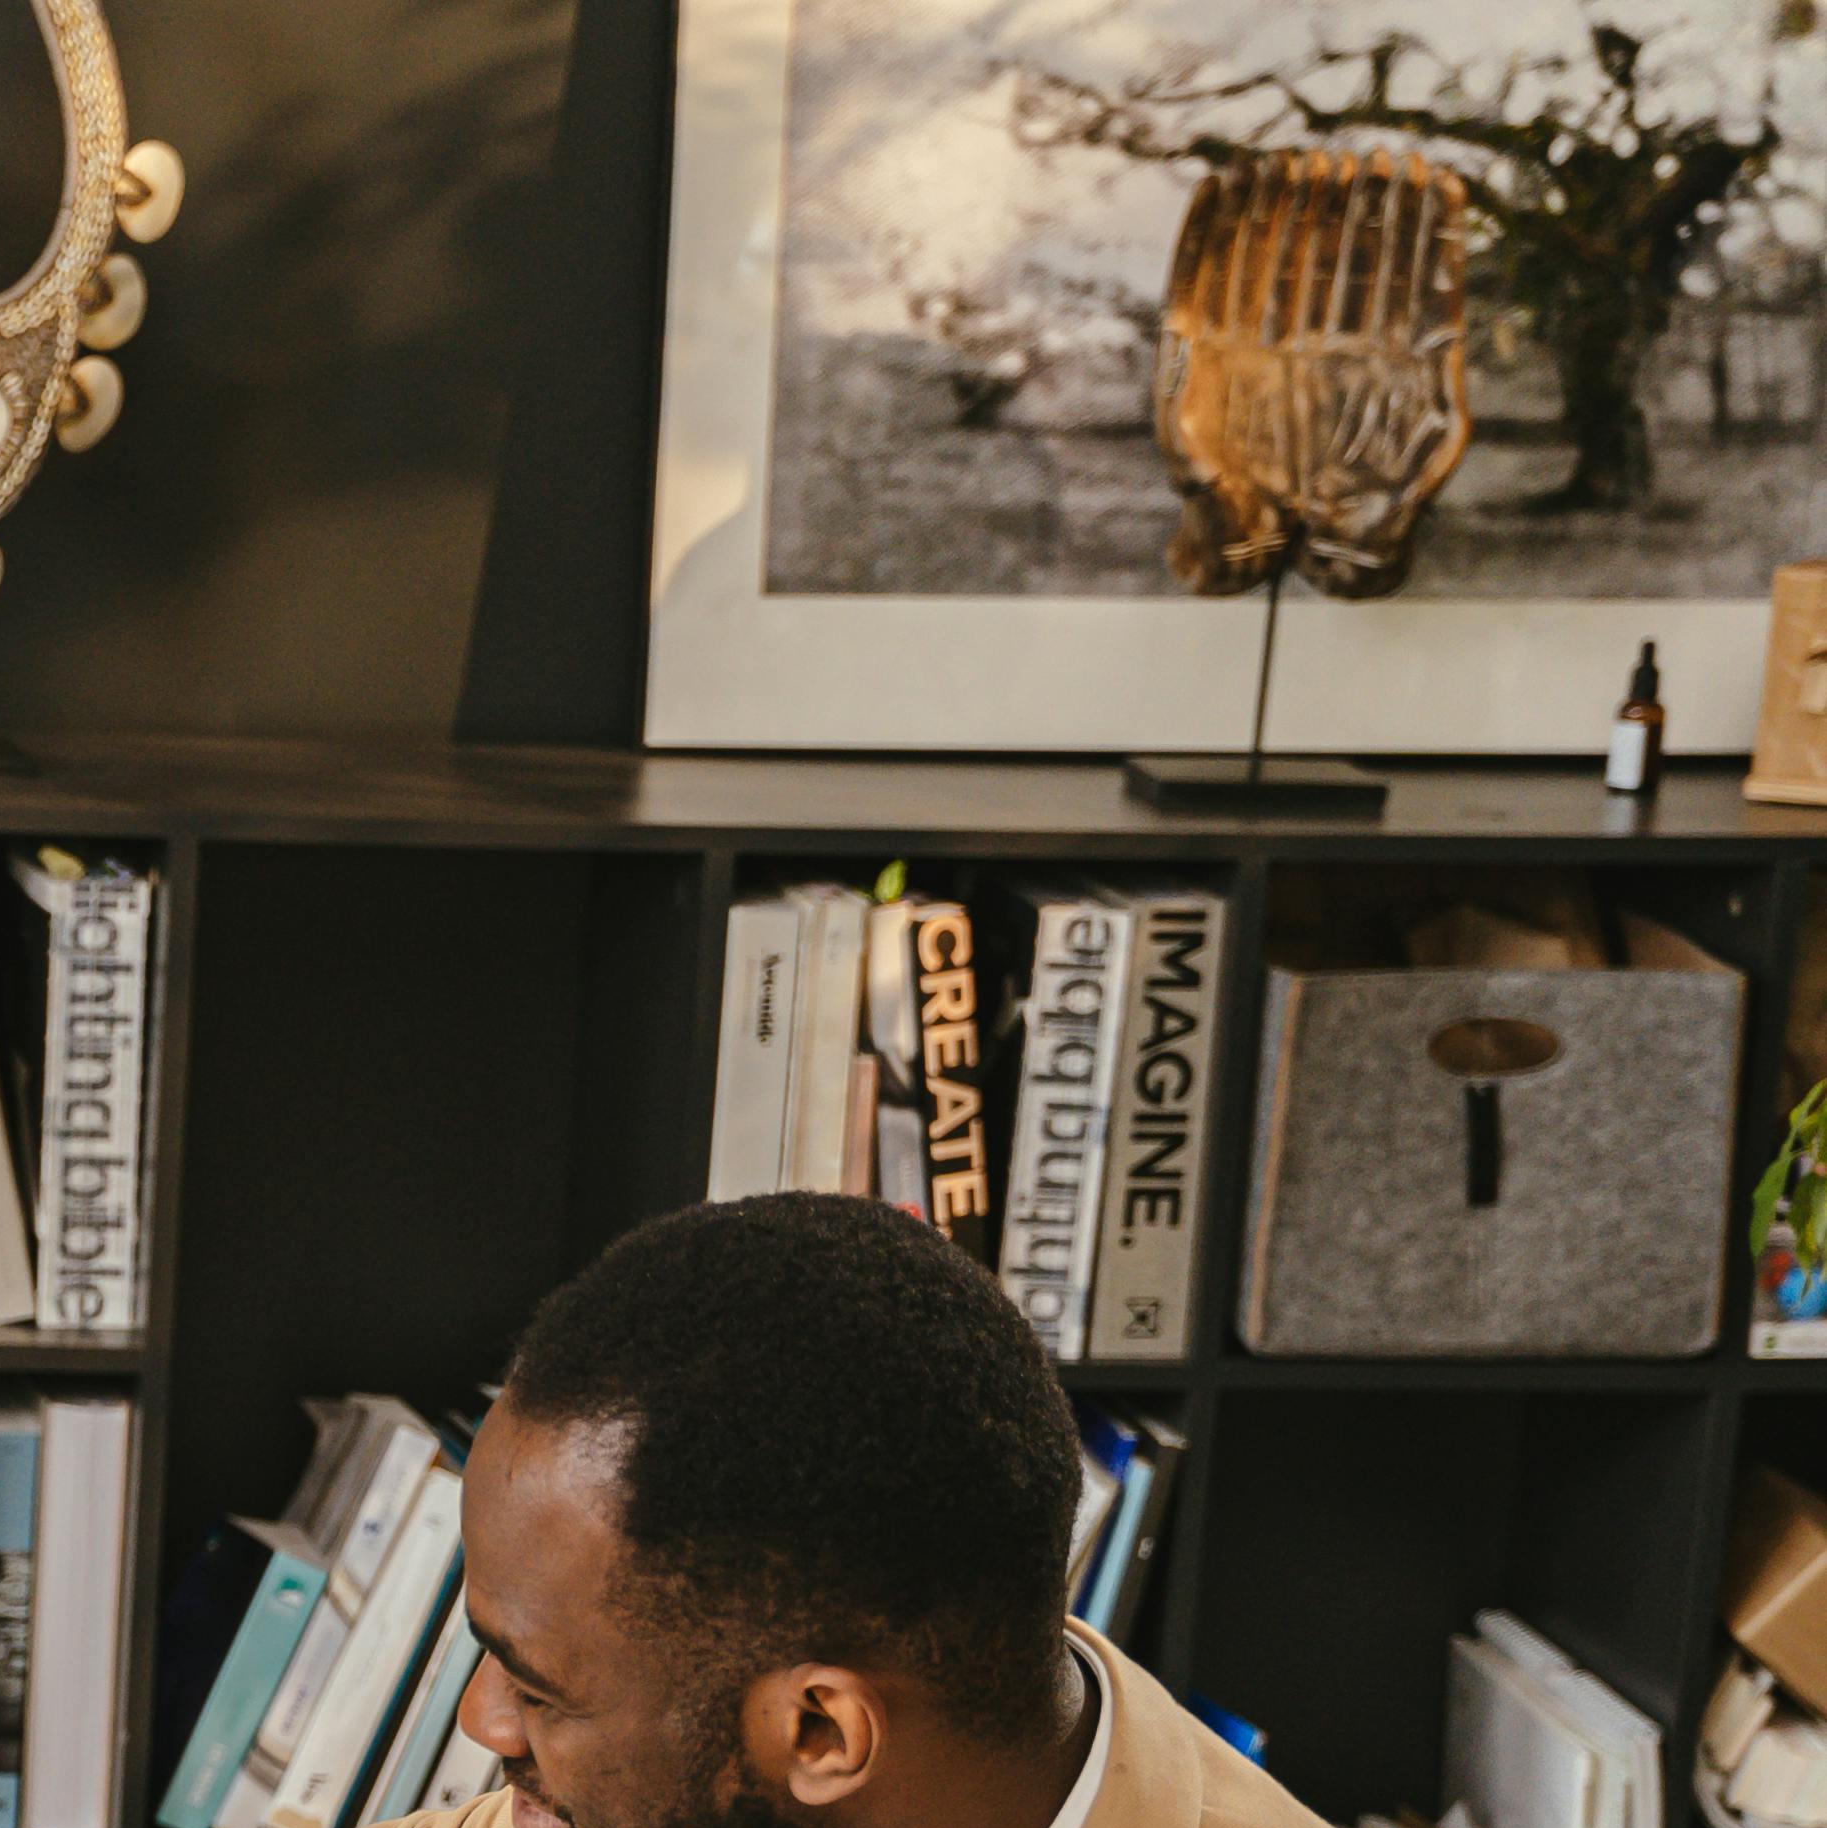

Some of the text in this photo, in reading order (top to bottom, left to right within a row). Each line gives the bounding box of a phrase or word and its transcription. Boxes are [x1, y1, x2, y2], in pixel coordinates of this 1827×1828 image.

[1033, 918, 1110, 1084] bible
[1119, 907, 1208, 1249] IMAGINE.
[54, 1157, 129, 1323] bible
